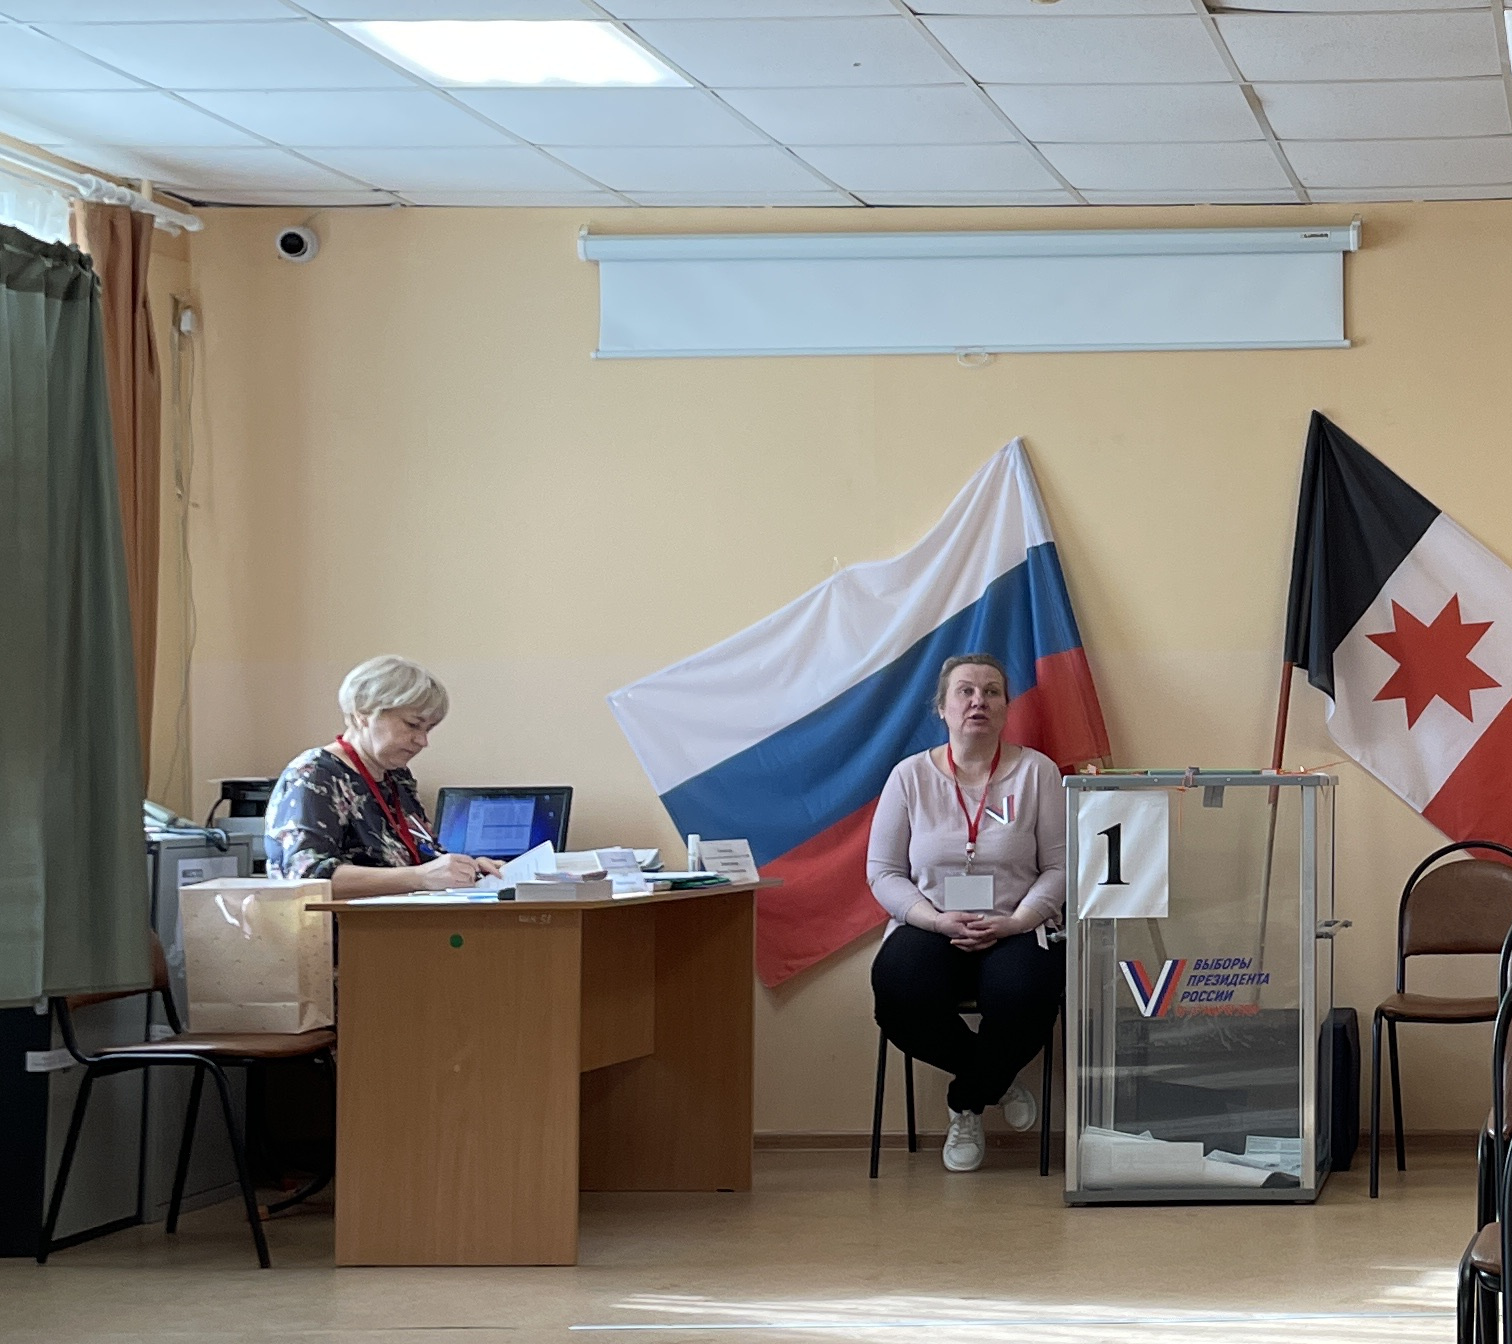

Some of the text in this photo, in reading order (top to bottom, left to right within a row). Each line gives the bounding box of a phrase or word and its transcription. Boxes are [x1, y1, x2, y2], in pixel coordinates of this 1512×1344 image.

[1096, 822, 1131, 886] 1
[1193, 957, 1253, 971] ВЫБОРЫ
[1186, 972, 1271, 987] ПРЕЗИДЕНТА
[1180, 989, 1235, 1003] РОССИИ
